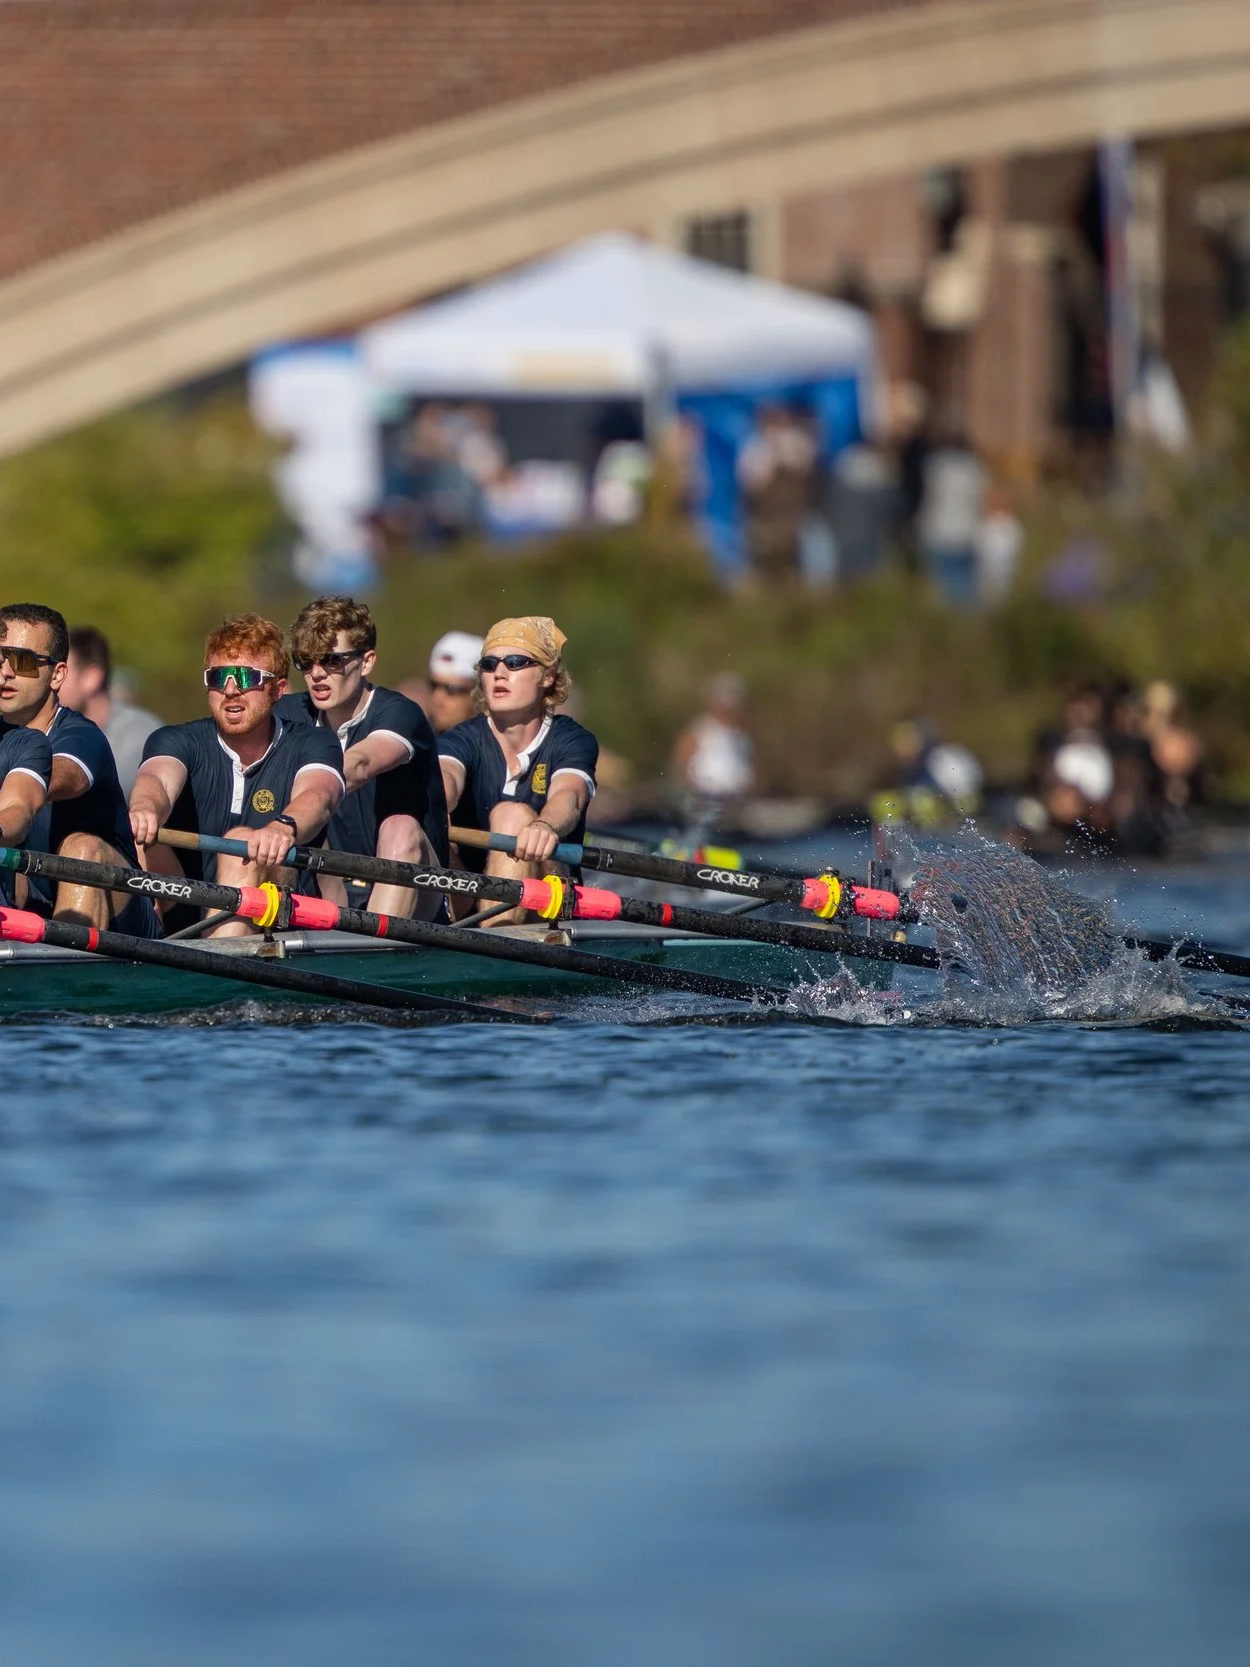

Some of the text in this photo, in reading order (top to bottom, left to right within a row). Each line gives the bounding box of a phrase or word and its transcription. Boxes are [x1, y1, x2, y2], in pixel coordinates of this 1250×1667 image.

[126, 876, 192, 899] CROKER
[413, 873, 479, 893] CROKER
[696, 868, 760, 890] CROKER
